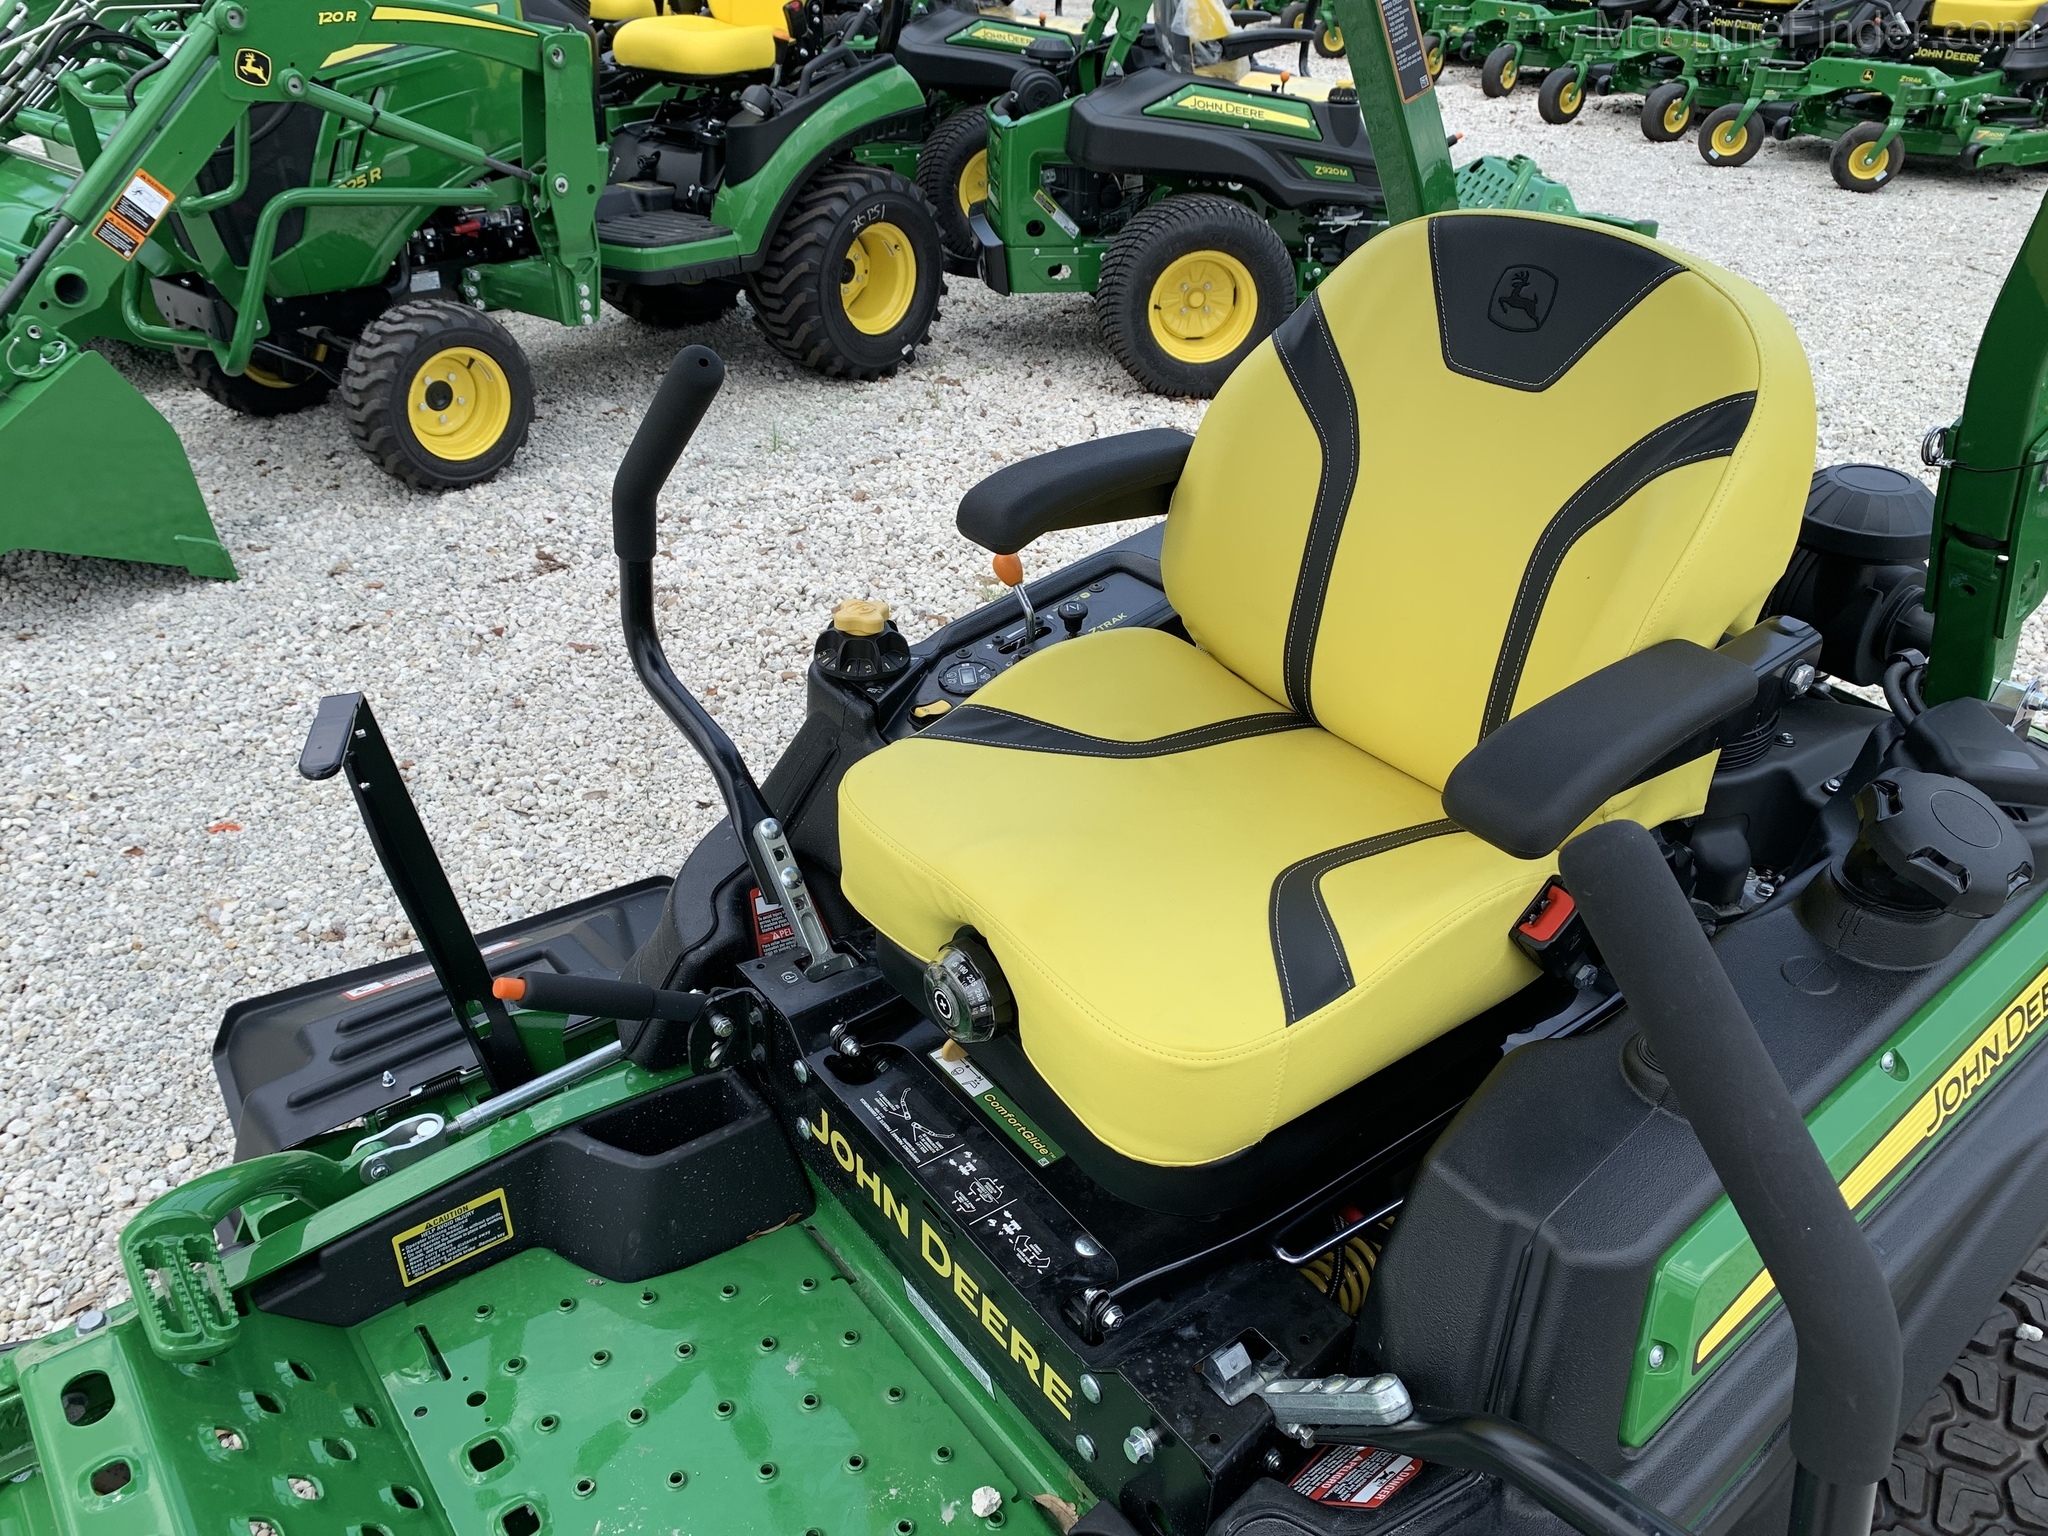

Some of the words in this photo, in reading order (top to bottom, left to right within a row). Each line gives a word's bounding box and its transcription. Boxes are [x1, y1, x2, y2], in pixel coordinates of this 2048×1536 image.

[1711, 16, 1733, 28] JOHN
[1735, 18, 1763, 32] DEERE
[980, 30, 1006, 40] JOHN
[1914, 47, 1944, 59] JOHN
[1944, 49, 1982, 63] DEERE
[1189, 97, 1223, 112] JOHN
[1225, 103, 1265, 119] DEERE
[1314, 165, 1348, 176] Z920M
[966, 974, 978, 987] 235
[974, 988, 985, 1002] 280
[979, 1003, 988, 1012] lb
[1926, 1032, 2000, 1134] JOHN
[432, 1205, 469, 1226] CAUTION
[811, 1108, 909, 1239] JOHN
[921, 1218, 1073, 1422] DEERE
[1321, 1461, 1357, 1489] PELIGRO
[1374, 1470, 1411, 1500] DANGER
